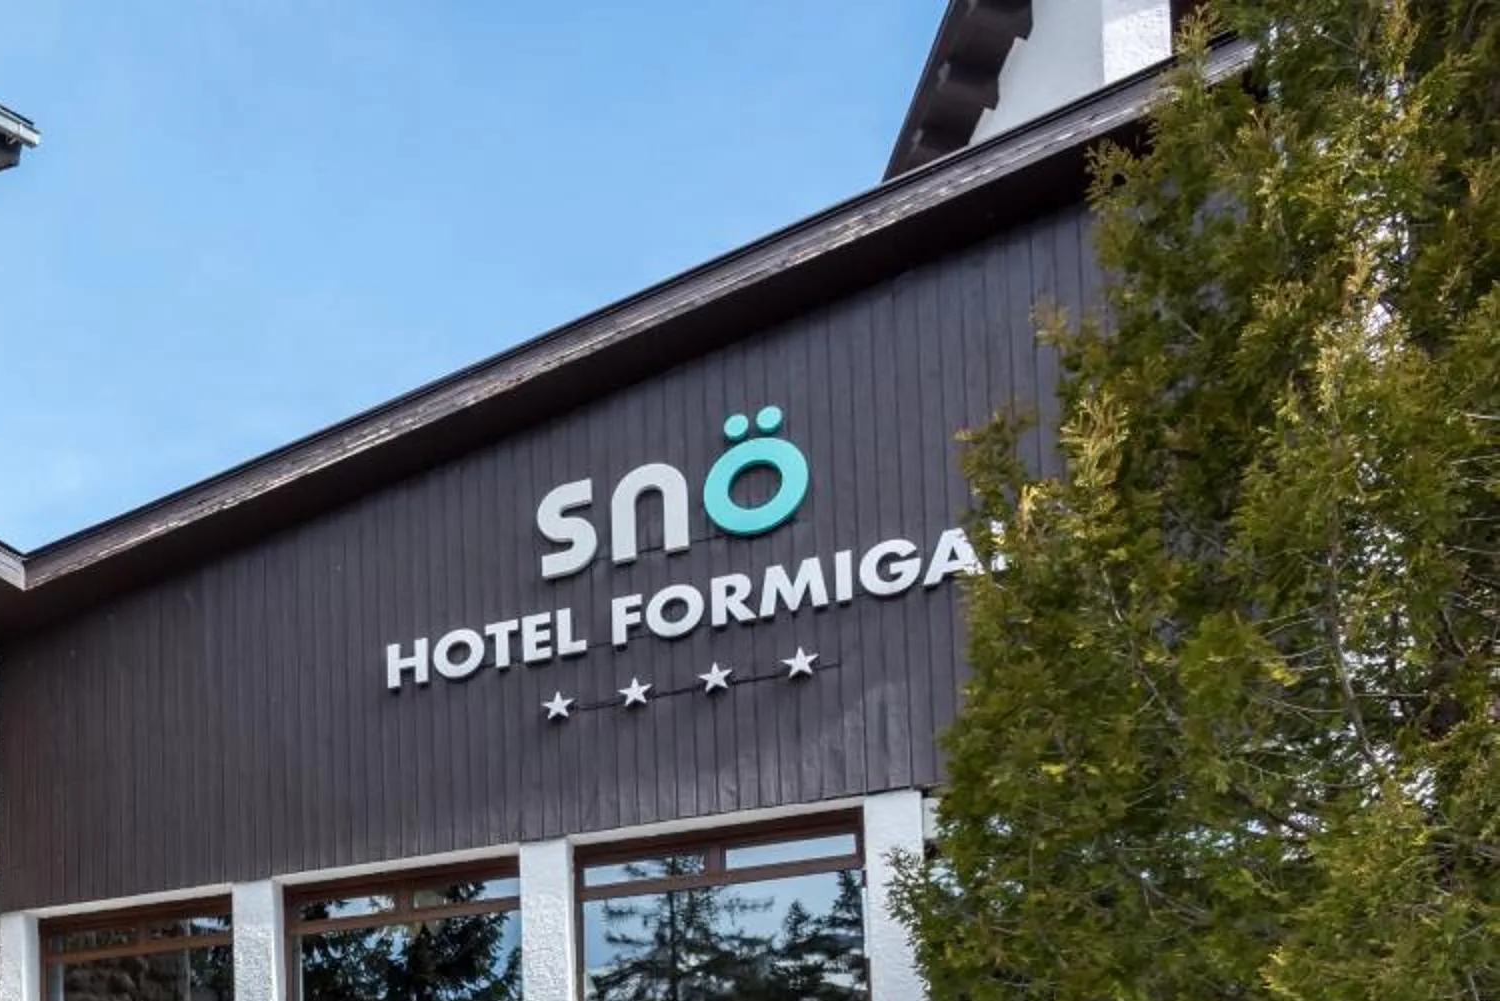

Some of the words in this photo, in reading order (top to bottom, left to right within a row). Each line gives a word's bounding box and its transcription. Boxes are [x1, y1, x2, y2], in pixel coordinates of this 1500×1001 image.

[536, 405, 810, 581] snö
[386, 606, 588, 690] HOTEL
[611, 520, 1012, 648] FORMIGA
